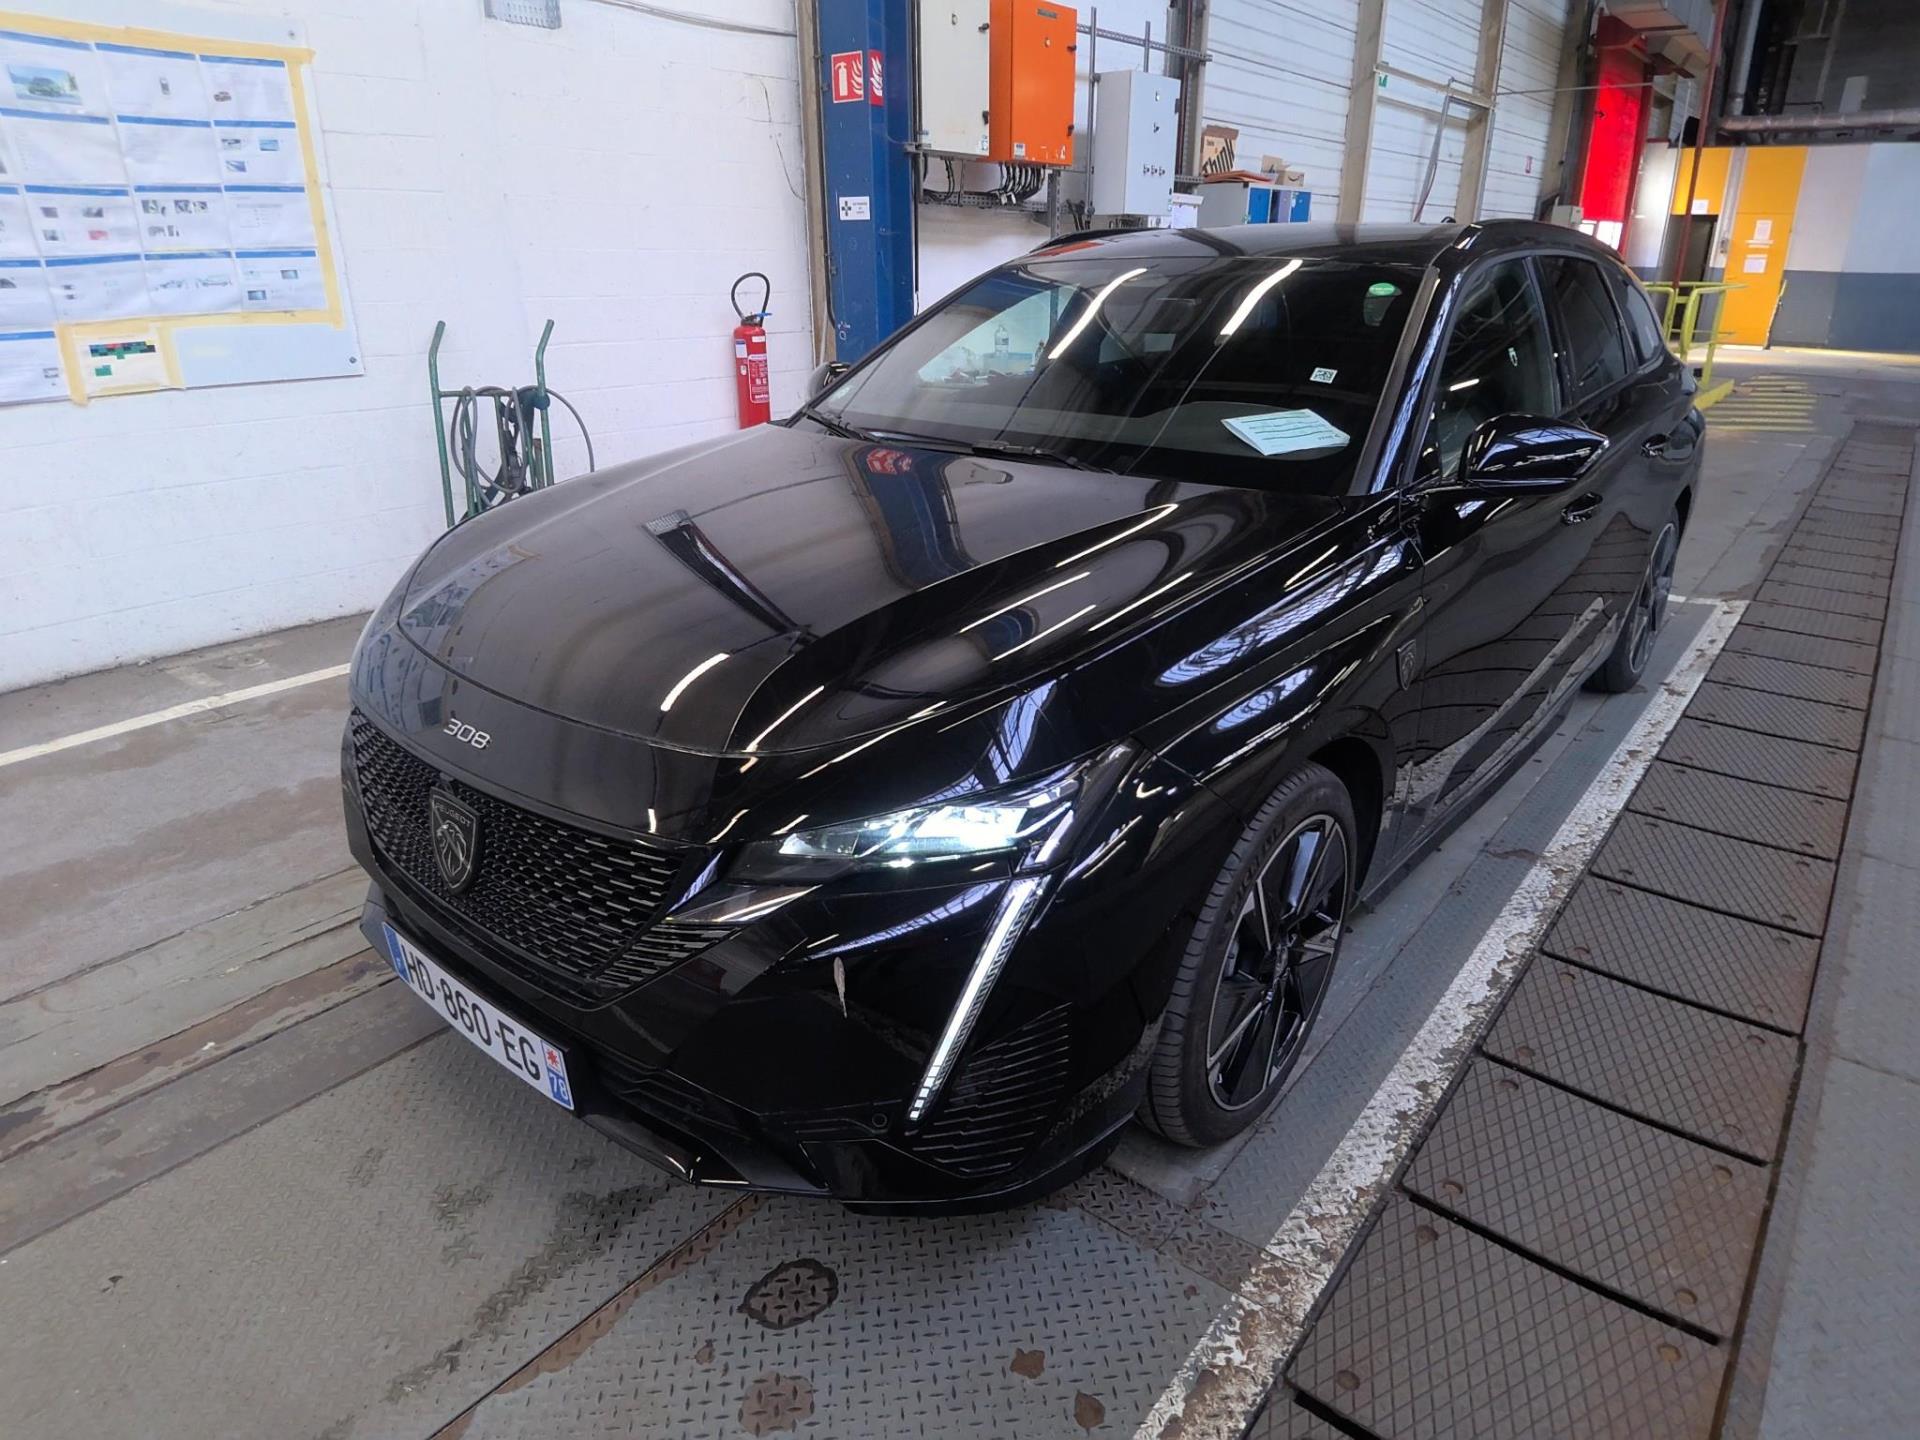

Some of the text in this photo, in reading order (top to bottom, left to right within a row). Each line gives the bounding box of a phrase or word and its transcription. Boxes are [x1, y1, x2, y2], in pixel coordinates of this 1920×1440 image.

[443, 718, 490, 749] 308
[402, 944, 541, 1081] HD-860-EG
[549, 1074, 569, 1099] 78
